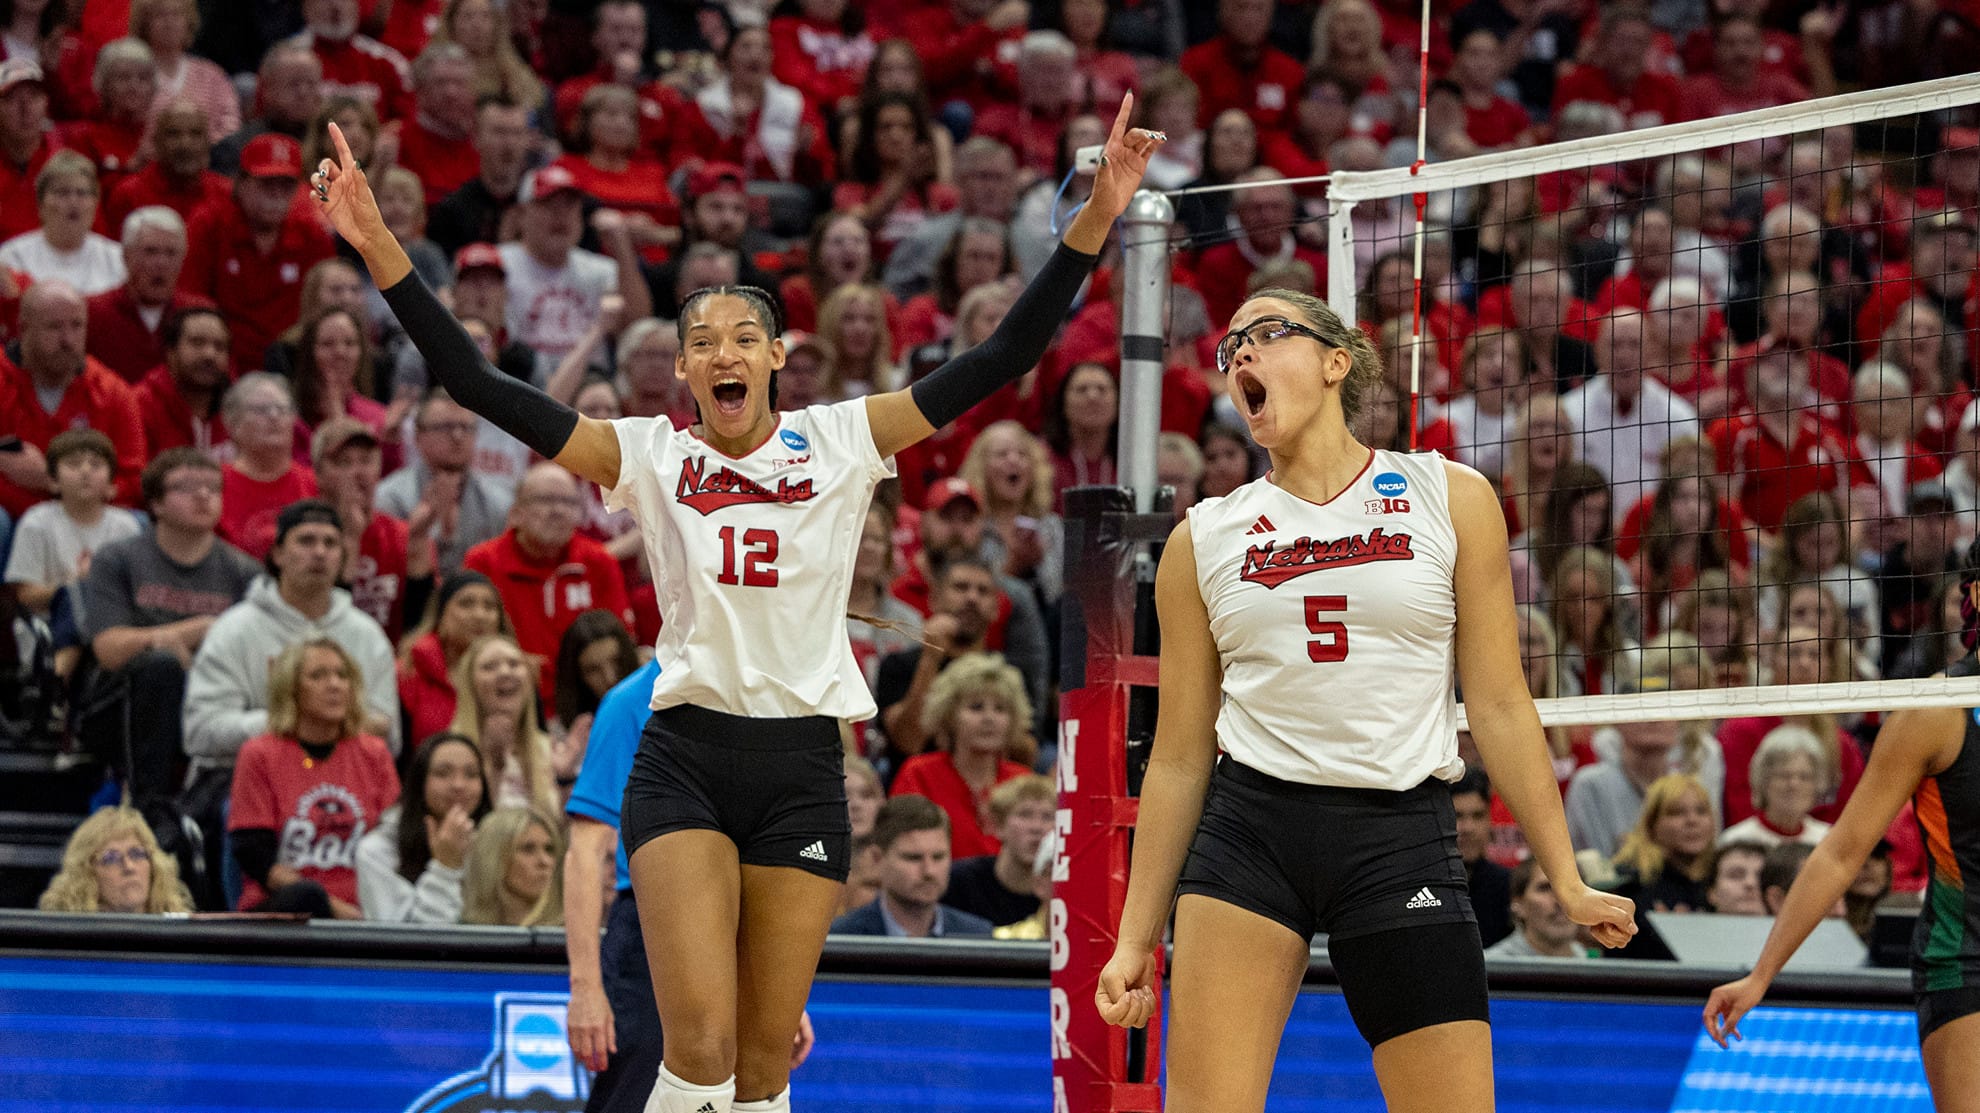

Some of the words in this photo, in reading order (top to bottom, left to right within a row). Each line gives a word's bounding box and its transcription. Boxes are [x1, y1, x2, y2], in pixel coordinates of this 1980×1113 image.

[717, 526, 779, 588] 12
[1240, 527, 1412, 578] Nebraska
[1303, 595, 1349, 663] 5
[800, 850, 828, 862] adidas
[1406, 899, 1442, 909] adidas
